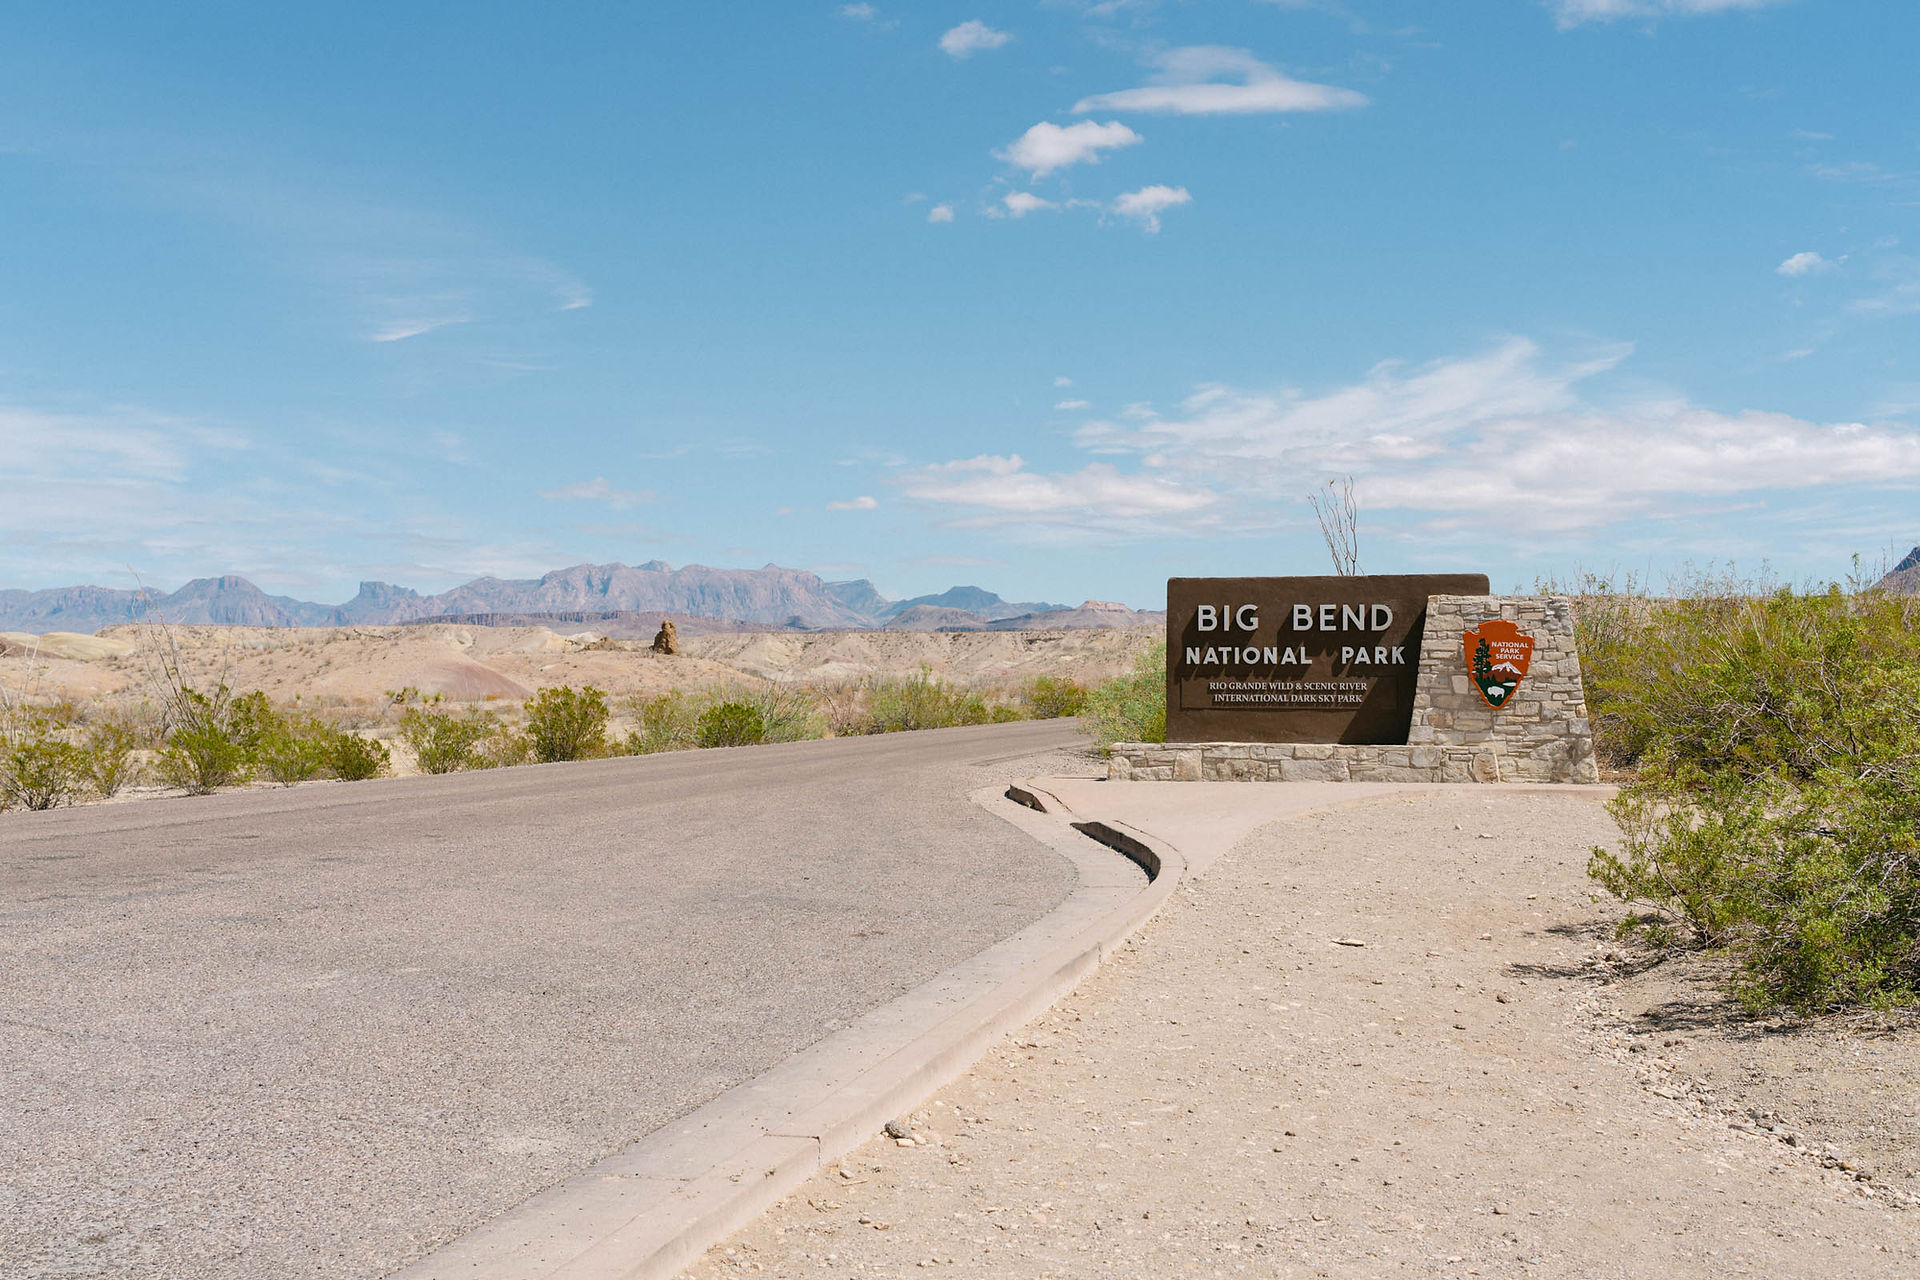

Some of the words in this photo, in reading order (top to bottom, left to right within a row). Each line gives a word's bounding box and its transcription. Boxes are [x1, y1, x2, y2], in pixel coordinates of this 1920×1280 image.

[1198, 604, 1259, 631] BIG
[1293, 604, 1393, 631] BEND
[1186, 647, 1313, 665] NATIONAL
[1341, 647, 1405, 665] PARK
[1209, 682, 1226, 690] RIO
[1229, 682, 1267, 690] GRANDE
[1269, 682, 1293, 690] WILD
[1295, 682, 1302, 690] &
[1304, 682, 1337, 690] SCENIC
[1339, 682, 1367, 691] RIVER
[1214, 694, 1290, 702] INTERNATIONAL
[1291, 694, 1317, 703] DARK
[1318, 694, 1337, 703] SKY
[1337, 694, 1362, 703] PARK
